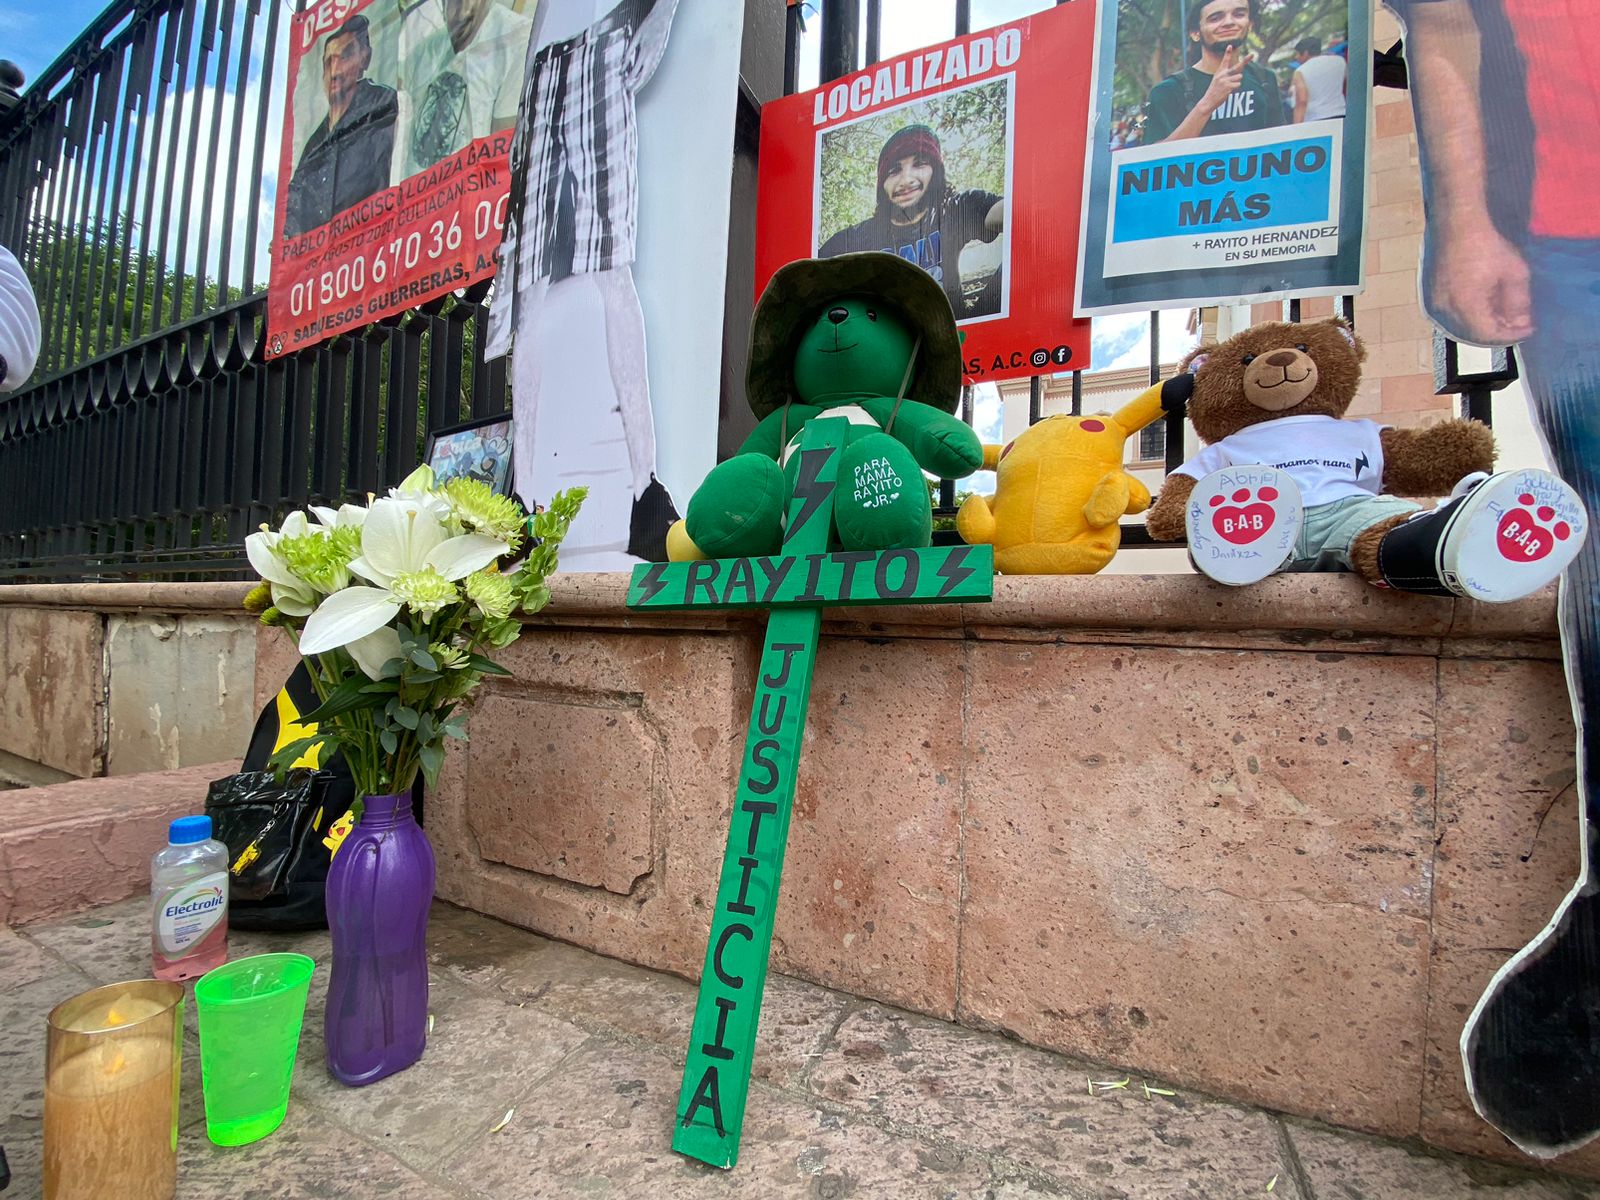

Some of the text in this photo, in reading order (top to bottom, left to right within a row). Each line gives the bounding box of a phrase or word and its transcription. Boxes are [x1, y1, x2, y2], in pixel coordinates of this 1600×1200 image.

[813, 27, 1021, 126] LOCALIZADO
[1121, 146, 1326, 195] NINGUNO
[282, 137, 511, 262] PABLO FRANCISCO LOAIZA GAR
[1178, 191, 1271, 227] MÁS
[1205, 237, 1248, 250] RAYITO
[1252, 226, 1338, 245] HERNANDEZ
[290, 278, 315, 317] 01
[320, 256, 365, 305] 800
[372, 231, 421, 283] 670
[428, 210, 462, 259] 36
[1225, 244, 1316, 261] EN SU MEMORIA
[293, 304, 363, 344] SABUESOS
[368, 262, 470, 314] GUERRERAS,
[991, 352, 1027, 371] A.C.
[854, 456, 890, 477] PARA
[1323, 460, 1352, 469] nana
[853, 477, 902, 501] RAYITO
[855, 466, 896, 489] MAMA
[872, 494, 892, 508] JR.
[1223, 514, 1263, 533] B-A-B
[1503, 521, 1541, 556] B-A-B
[683, 549, 920, 605] RAYITO
[681, 643, 806, 1139] JUSTICIA
[166, 895, 224, 917] Electrolit
